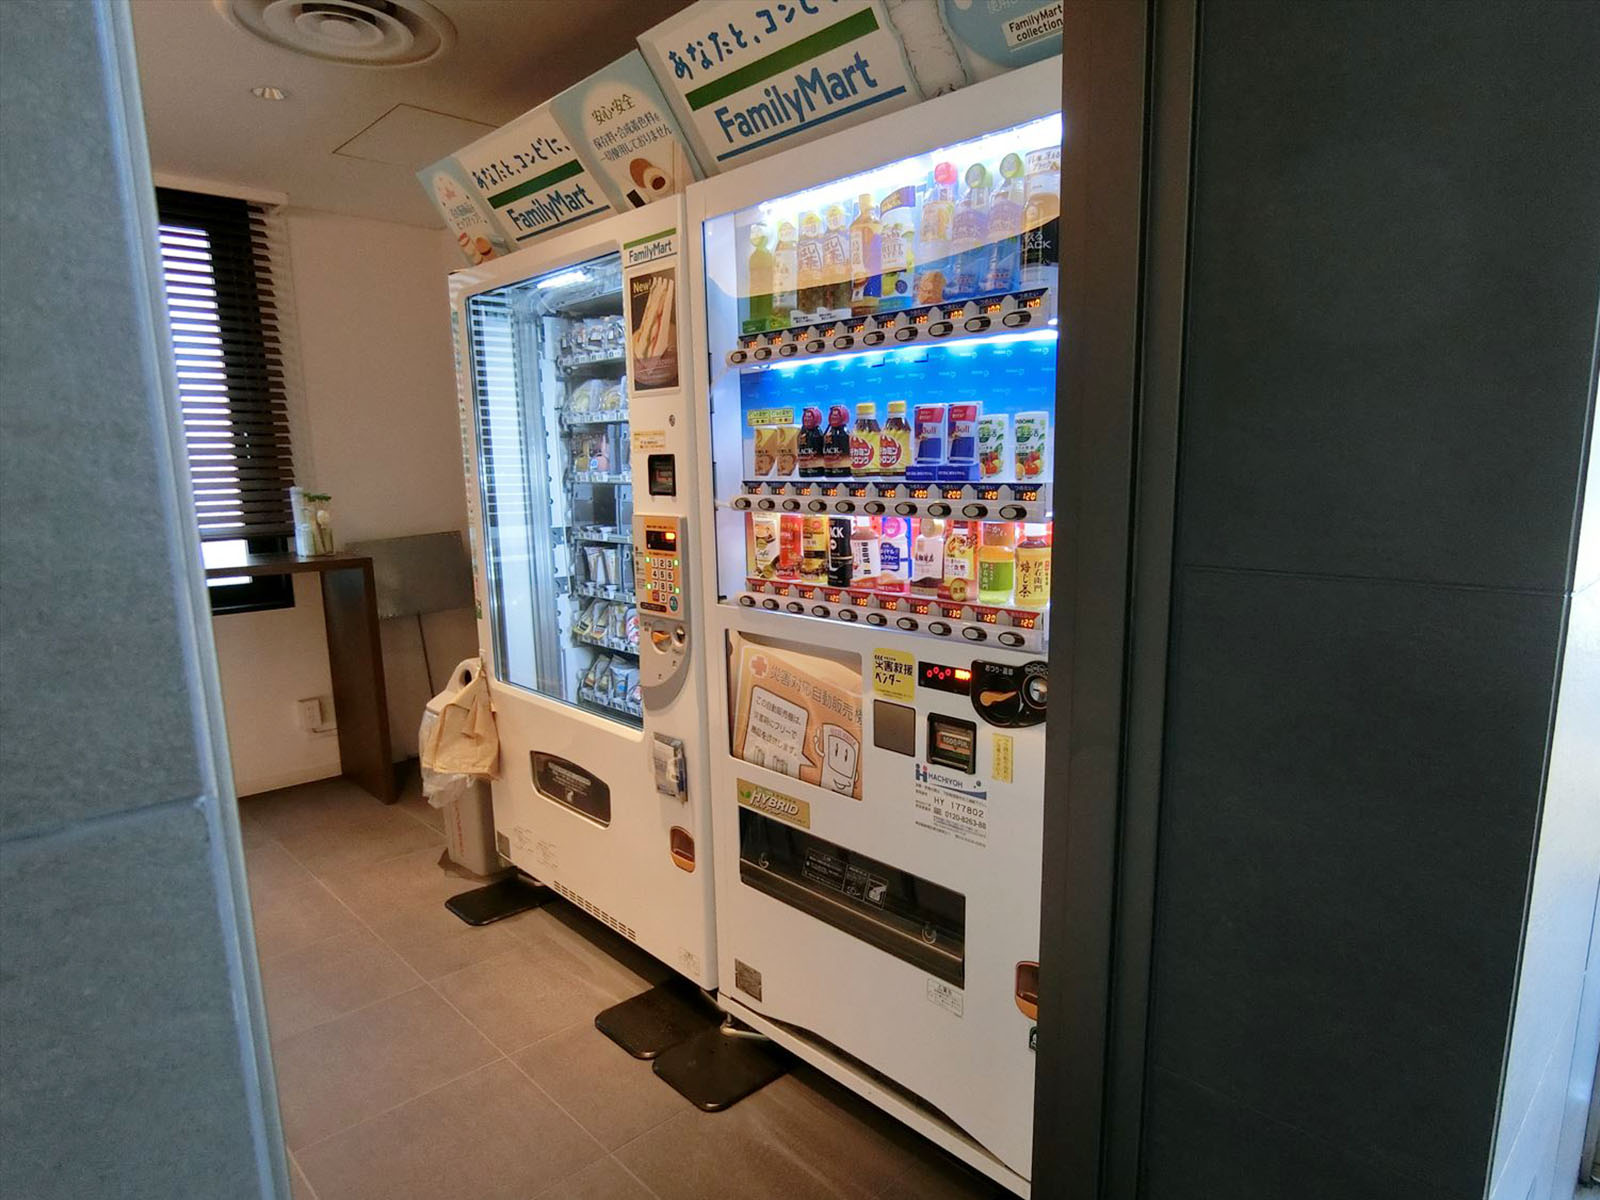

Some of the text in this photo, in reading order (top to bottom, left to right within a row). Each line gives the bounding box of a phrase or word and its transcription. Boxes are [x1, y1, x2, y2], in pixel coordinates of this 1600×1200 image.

[1009, 4, 1063, 33] FamilyMart
[1016, 19, 1063, 42] collection
[714, 51, 878, 143] FamilyMart
[507, 183, 594, 231] FamilyMart
[629, 240, 672, 263] FamilyMart
[914, 490, 928, 498] 200
[947, 490, 961, 498] 200
[984, 491, 998, 499] 120
[1023, 491, 1036, 500] 120
[916, 605, 928, 614] 150
[949, 609, 961, 618] 130
[985, 614, 997, 623] 120
[1021, 618, 1034, 628] 120
[928, 773, 963, 788] HACHIYOH
[750, 790, 799, 815] HYBRID
[934, 797, 984, 818] HY 177802
